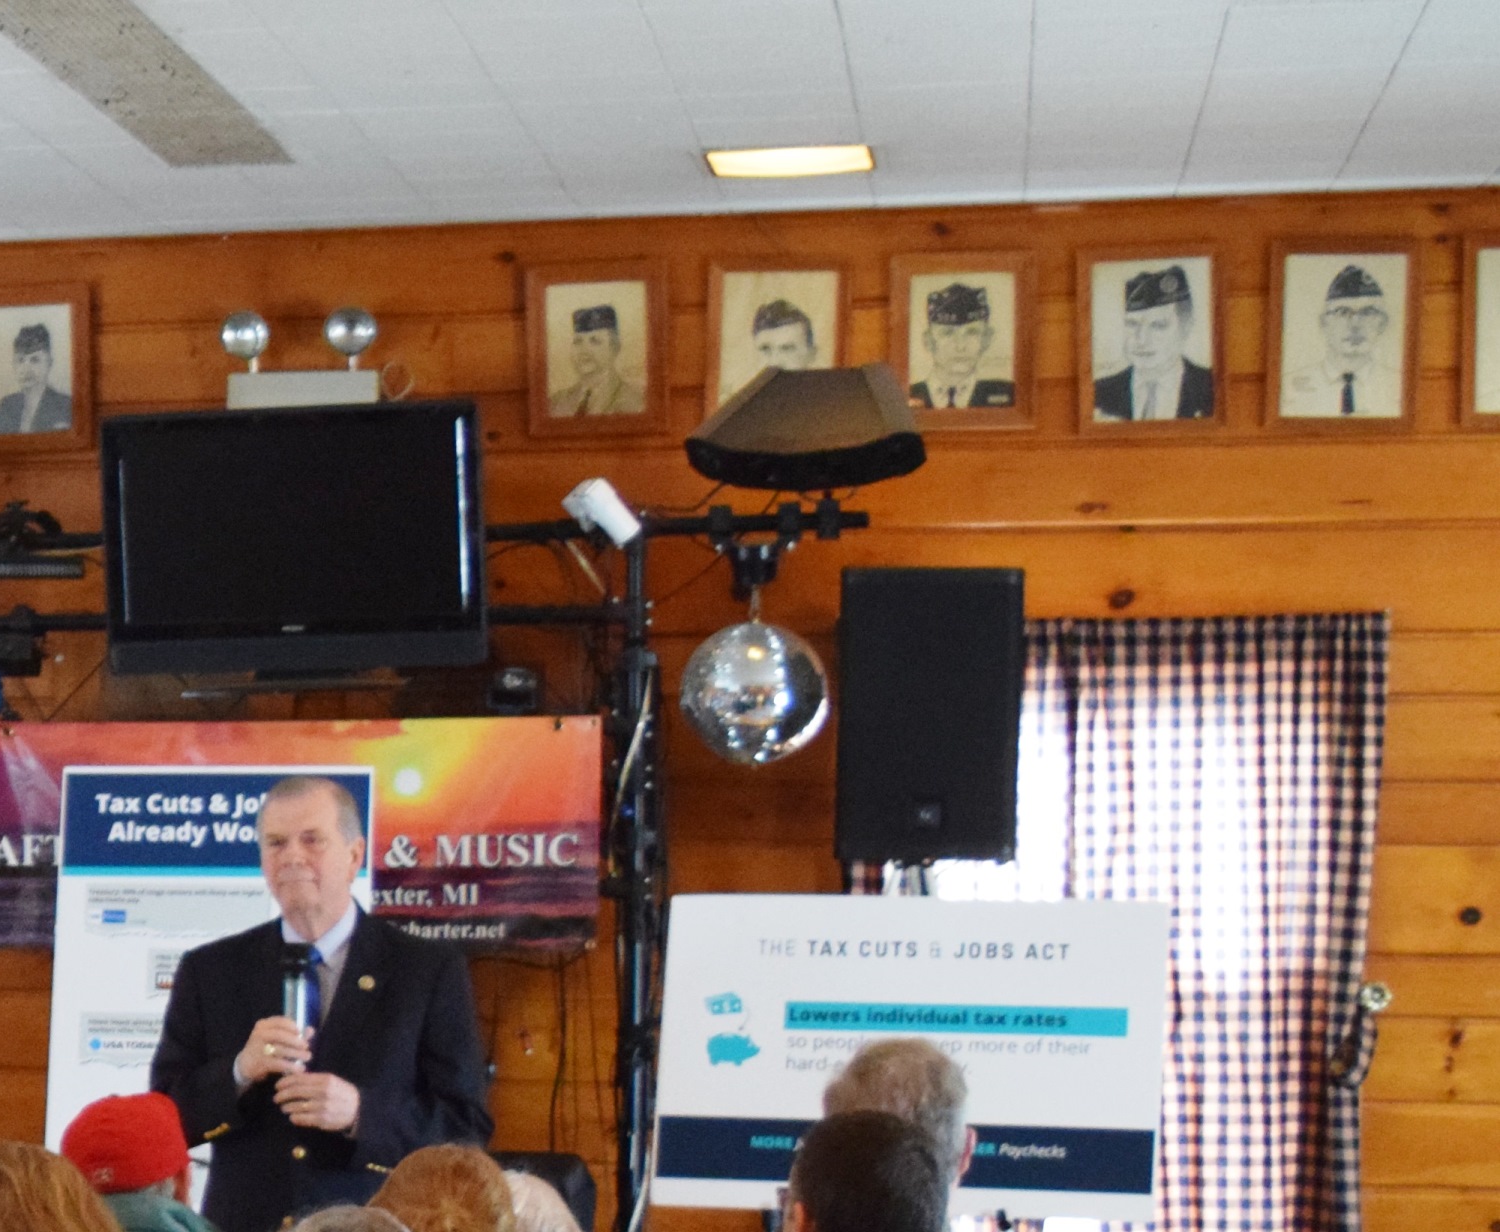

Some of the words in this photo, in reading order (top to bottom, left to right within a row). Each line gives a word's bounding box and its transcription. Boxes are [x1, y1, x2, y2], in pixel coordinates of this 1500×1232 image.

[95, 793, 141, 814] Tax
[146, 793, 203, 814] Cuts
[209, 793, 229, 814] &
[108, 821, 207, 847] Already
[384, 834, 418, 868] &
[435, 833, 579, 867] MUSIC
[371, 886, 433, 907] exter,
[441, 883, 480, 905] MI
[402, 921, 507, 939] harter.net
[757, 939, 796, 956] THE
[807, 940, 848, 958] TAX
[858, 940, 918, 958] CUTS
[953, 943, 1014, 959] JOBS
[1024, 943, 1070, 960] ACT
[788, 1007, 861, 1023] Lowers
[866, 1010, 967, 1025] individual
[974, 1012, 1006, 1025] tax
[1012, 1014, 1068, 1028] rates
[786, 1036, 807, 1048] so
[813, 1035, 864, 1051] peopl
[968, 1040, 1017, 1053] more
[1023, 1038, 1044, 1054] of
[1048, 1040, 1092, 1056] their
[751, 1136, 792, 1149] MORE
[999, 1142, 1067, 1161] Paychecks
